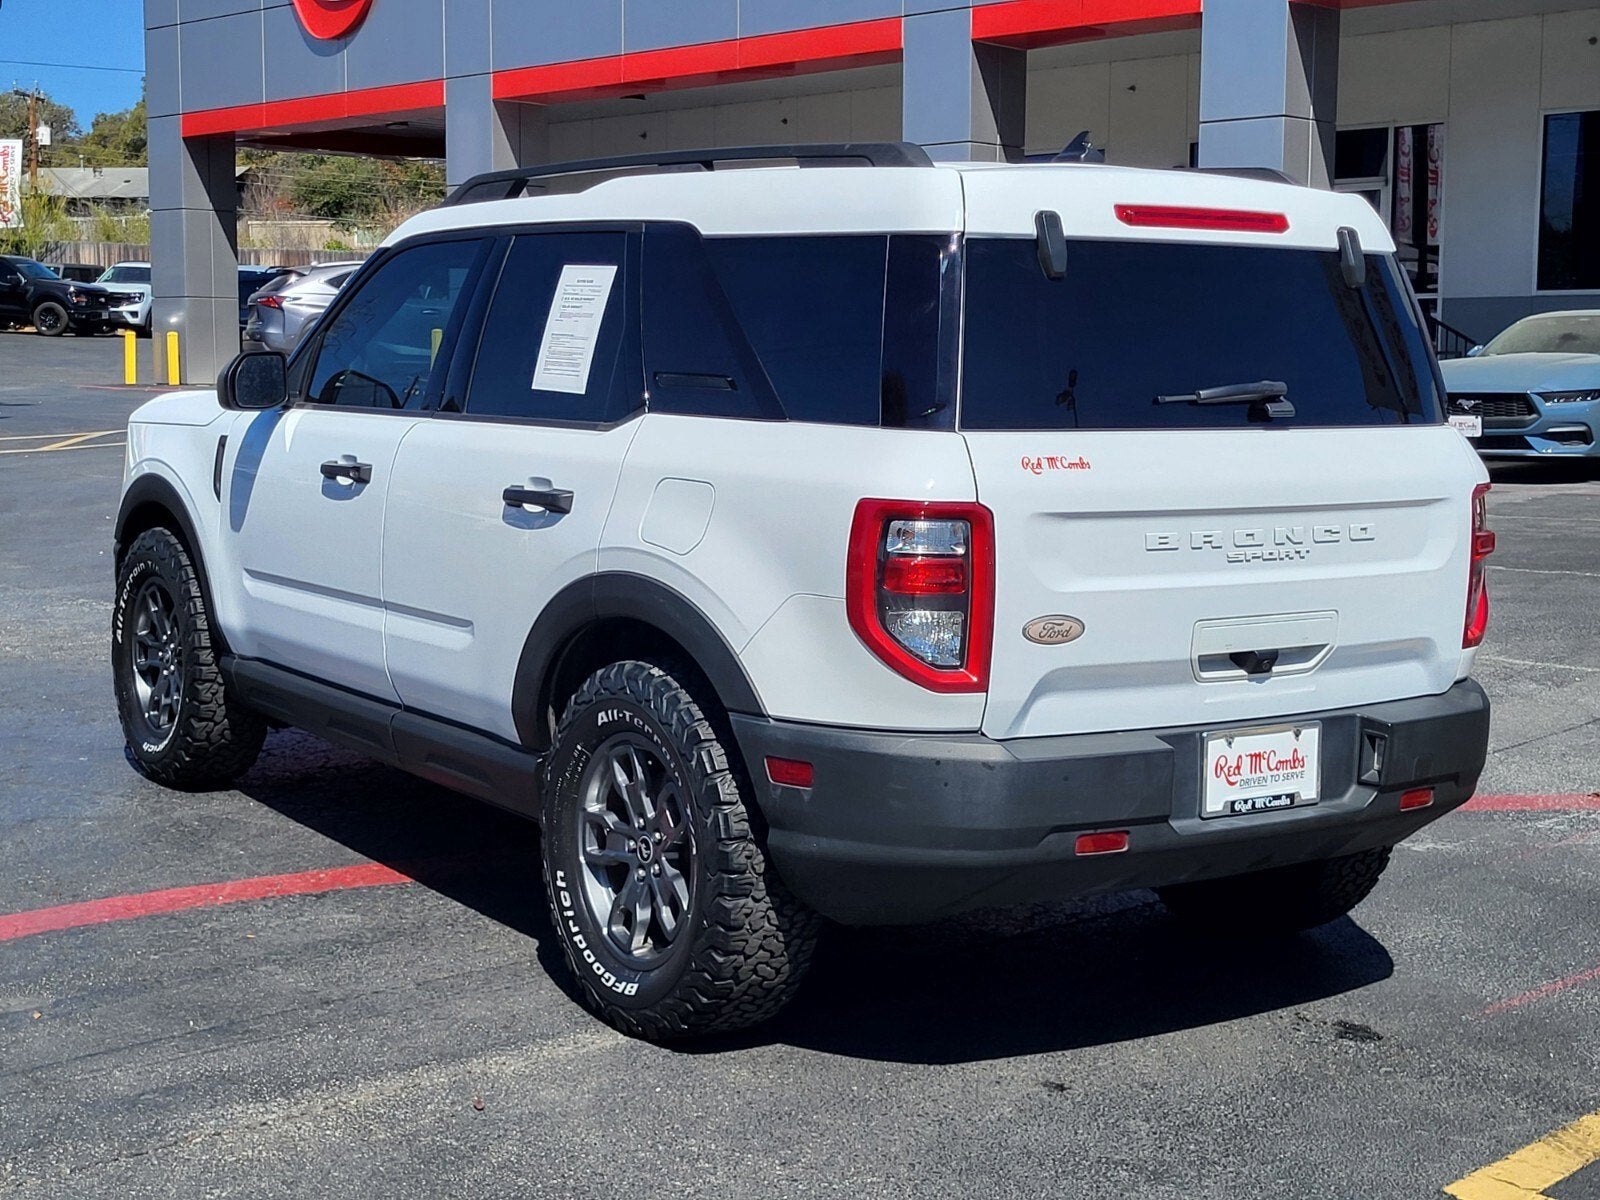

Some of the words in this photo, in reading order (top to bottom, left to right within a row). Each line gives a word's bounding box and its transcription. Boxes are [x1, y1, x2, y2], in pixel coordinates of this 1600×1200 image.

[1021, 456, 1043, 475] Red
[1043, 456, 1091, 470] McCombs
[1145, 523, 1376, 551] BRONCO
[1226, 548, 1310, 563] SPORT
[116, 561, 146, 645] All-Terrain
[1038, 621, 1073, 639] Ford
[1214, 754, 1242, 787] Red
[1245, 747, 1306, 775] McCombs
[1239, 775, 1268, 788] DRIVEN
[1270, 774, 1280, 783] TO
[1281, 770, 1306, 782] SERVE
[1234, 799, 1253, 812] Red
[1253, 795, 1291, 810] McCombs
[555, 870, 639, 996] BFGoodrich
